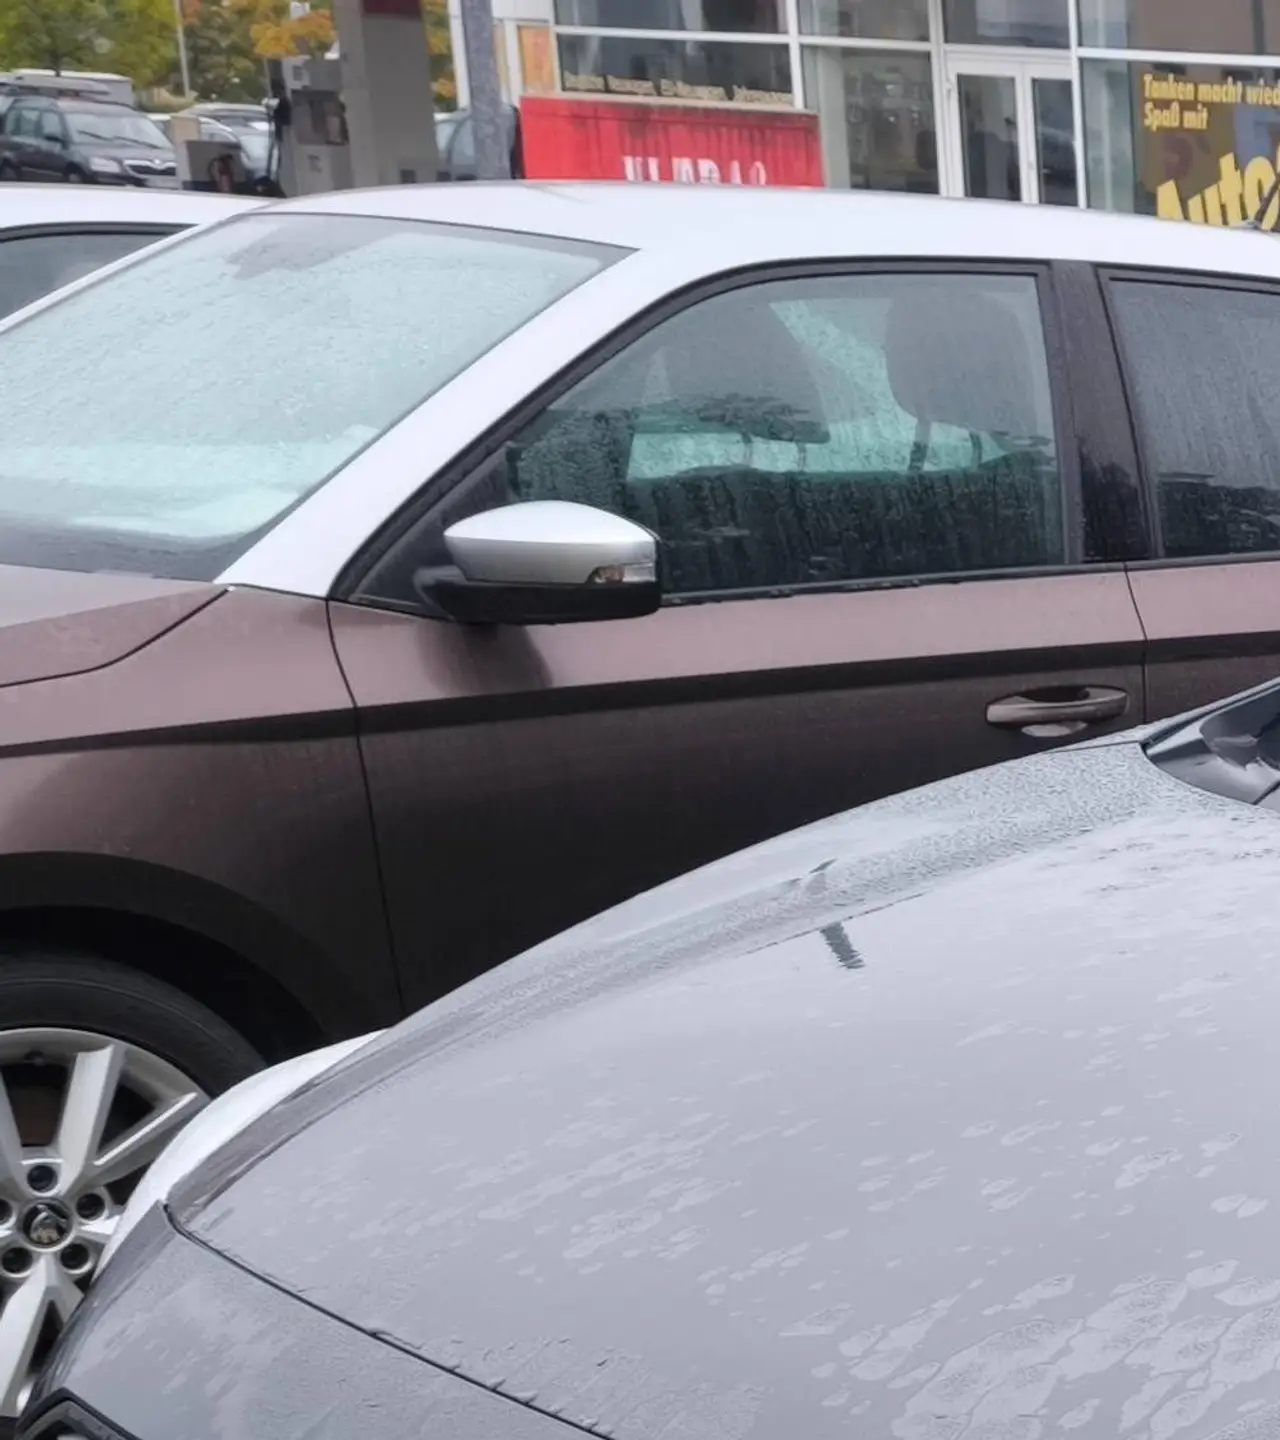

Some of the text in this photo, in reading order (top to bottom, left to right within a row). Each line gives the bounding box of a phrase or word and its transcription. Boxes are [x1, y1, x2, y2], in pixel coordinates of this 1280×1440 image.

[1143, 73, 1195, 100] Tanken
[1197, 76, 1243, 104] macht
[1144, 102, 1209, 132] Spaß mit
